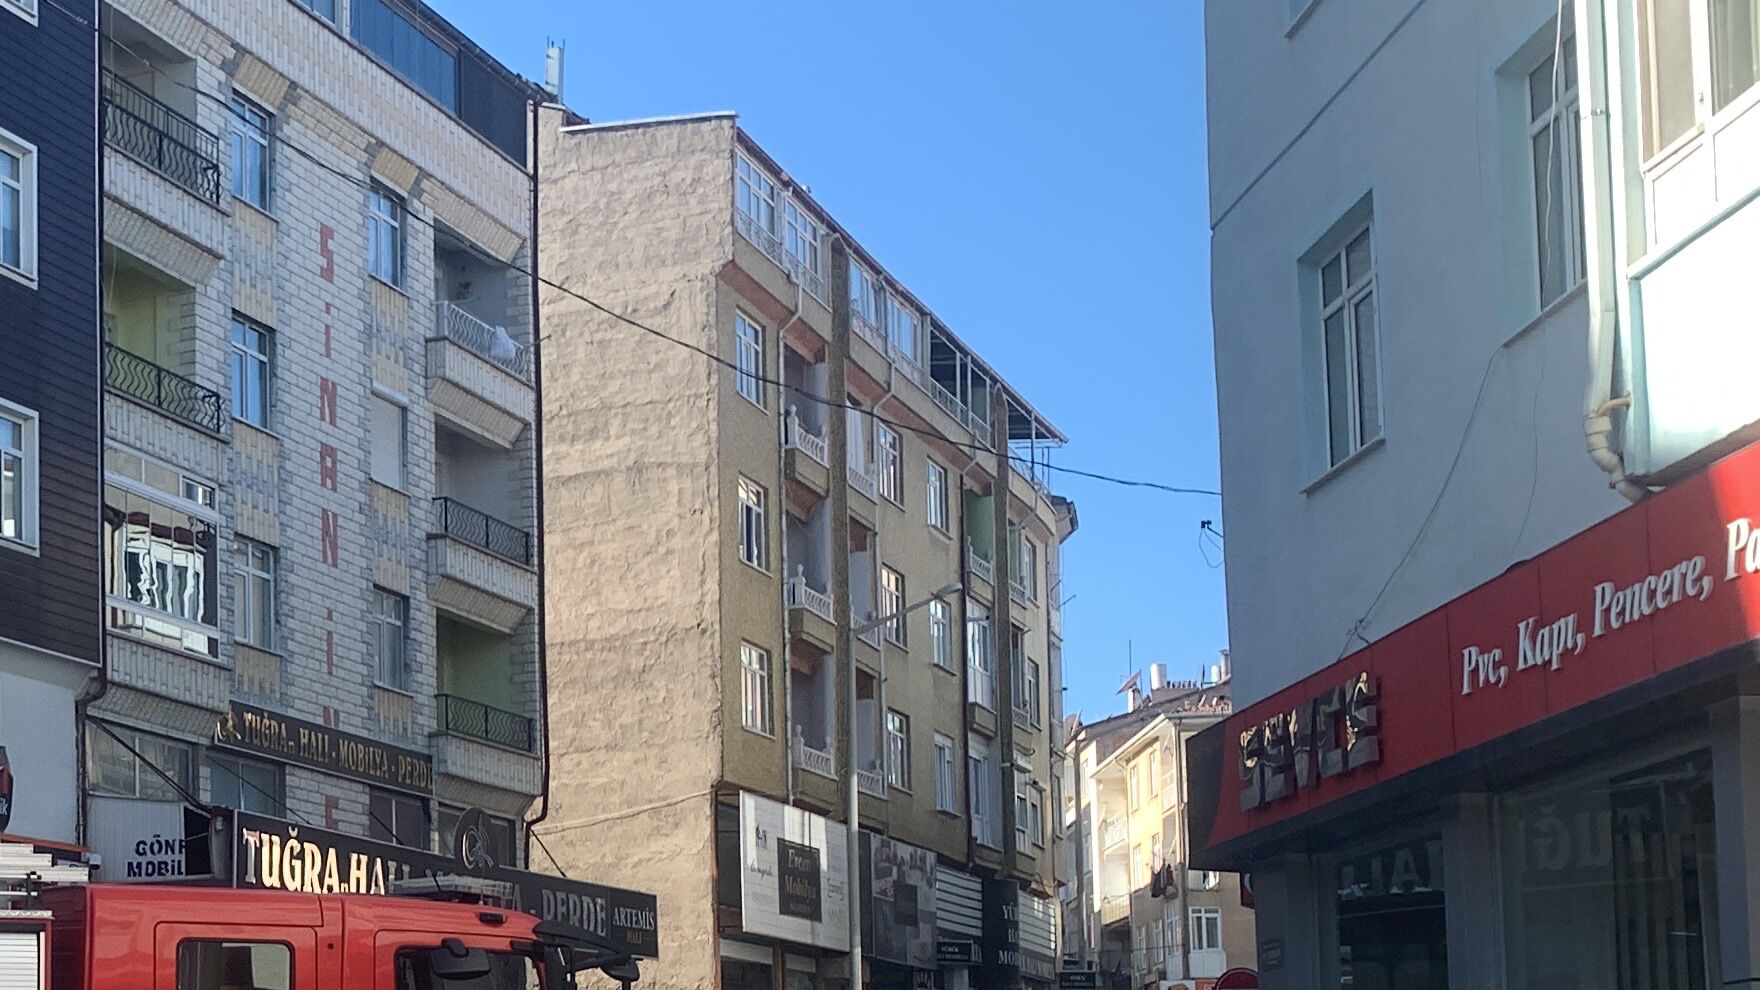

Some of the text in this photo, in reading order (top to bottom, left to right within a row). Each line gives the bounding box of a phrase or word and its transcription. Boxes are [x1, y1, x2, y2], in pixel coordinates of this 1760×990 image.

[1461, 646, 1508, 696] Pvc,
[1592, 555, 1715, 638] Pencere,
[127, 859, 184, 878] MOBİL
